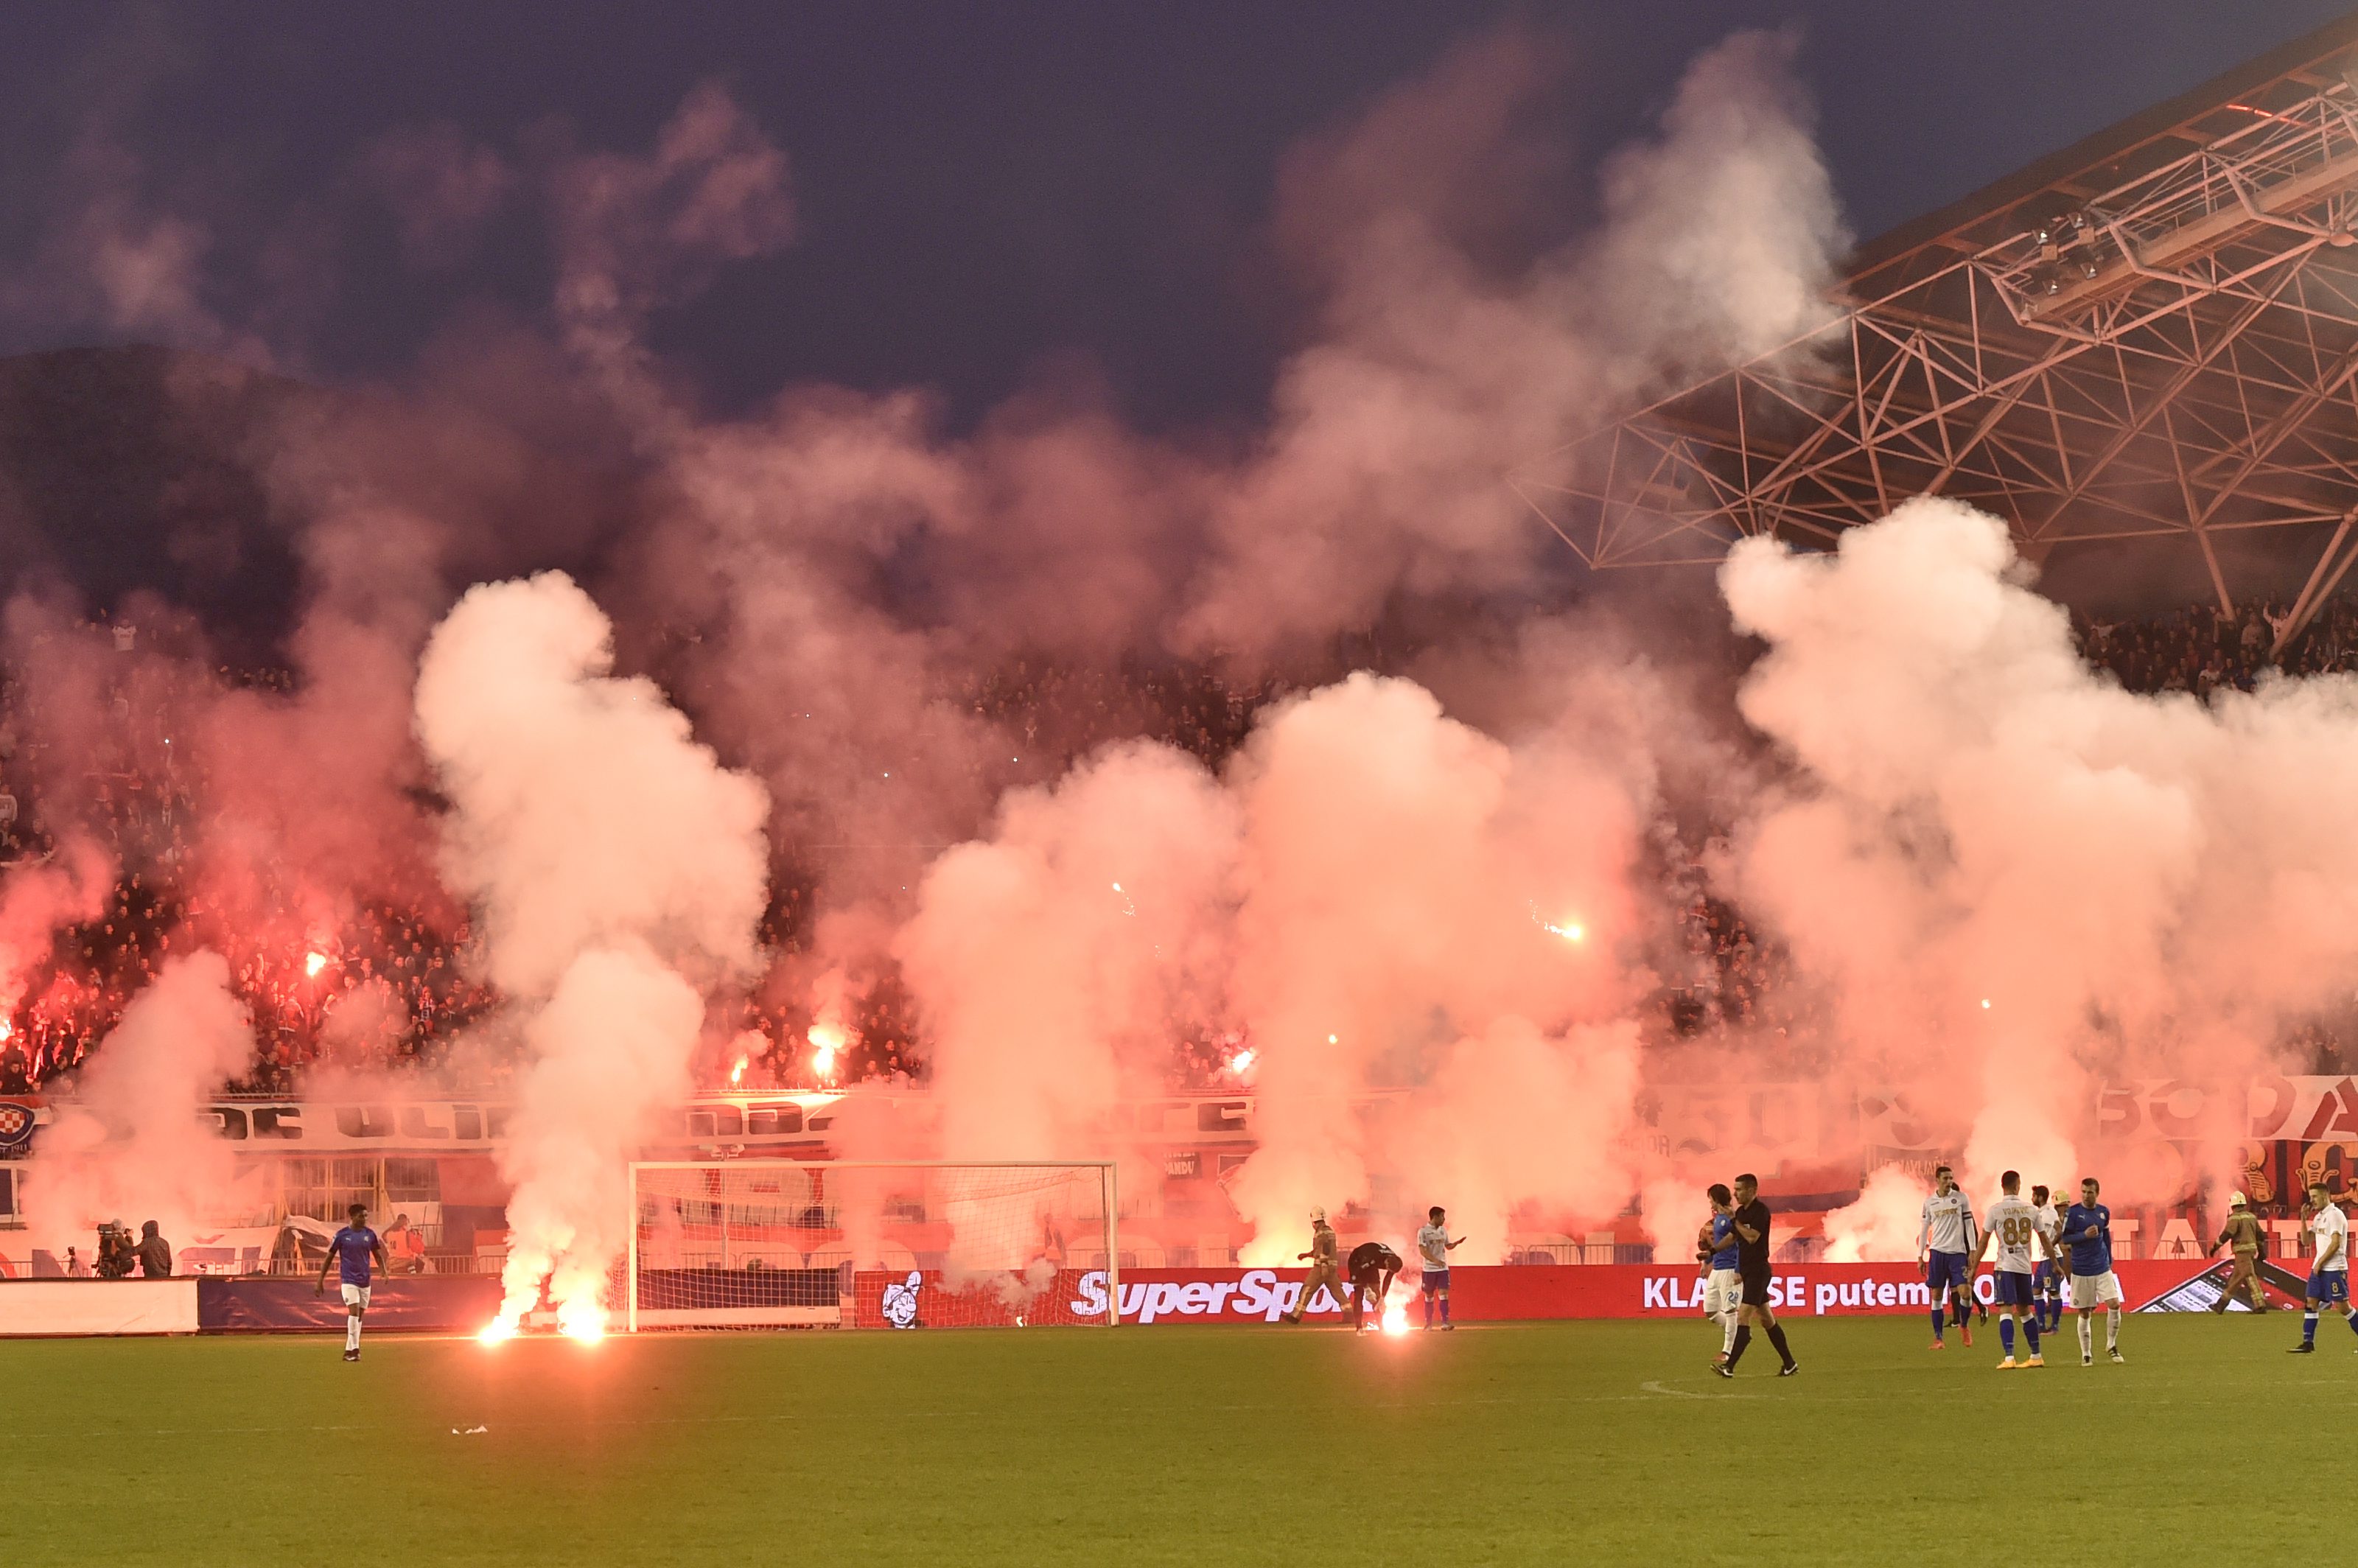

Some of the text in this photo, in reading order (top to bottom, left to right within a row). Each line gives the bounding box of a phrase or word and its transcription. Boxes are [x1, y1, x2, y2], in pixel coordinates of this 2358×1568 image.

[2004, 1217, 2032, 1245] 88
[1816, 1278, 1931, 1315] putem
[2331, 1282, 2339, 1293] 8
